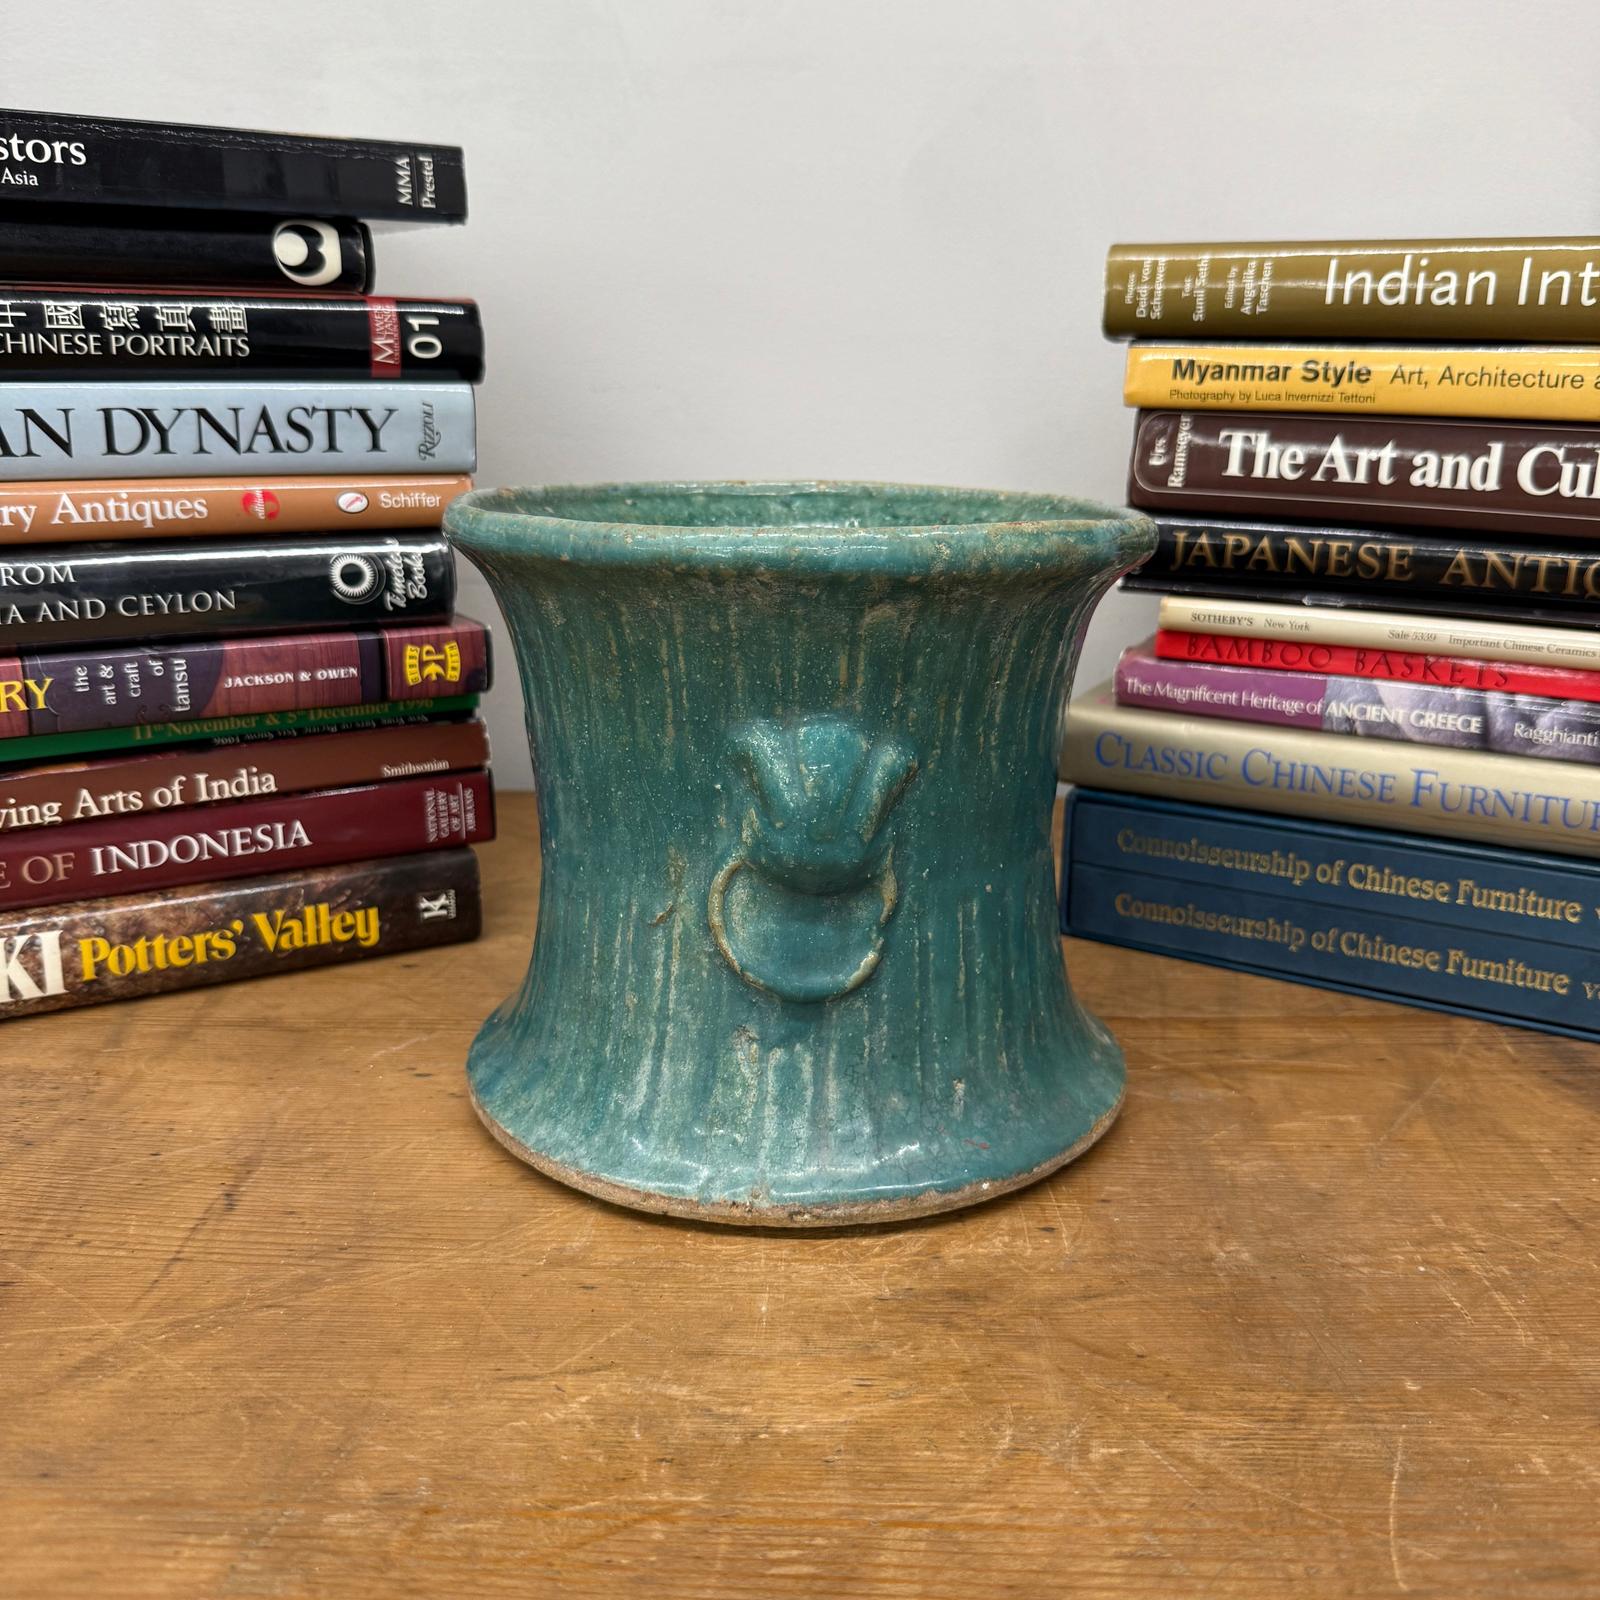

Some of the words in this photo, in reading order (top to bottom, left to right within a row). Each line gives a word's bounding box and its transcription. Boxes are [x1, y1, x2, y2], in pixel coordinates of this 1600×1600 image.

[1, 166, 39, 185] Asia
[396, 157, 413, 205] MMA
[418, 154, 436, 208] Prestel
[1241, 259, 1257, 315] Angelika
[1256, 260, 1273, 315] Taschen
[1324, 255, 1497, 306] Indian
[0, 332, 102, 355] HINESE
[112, 333, 250, 357] PORTRAITS
[405, 315, 442, 359] 01
[1169, 389, 1235, 402] Photography
[1238, 390, 1251, 403] by
[1255, 390, 1281, 402] Luca
[1285, 391, 1334, 403] Invernizzi
[1338, 391, 1376, 404] Tettoni
[1171, 358, 1292, 386] Myanmar
[1301, 359, 1372, 388] Style
[1389, 365, 1428, 388] Art,
[1437, 366, 1585, 390] Architecture
[98, 405, 399, 456] DYNASTY
[1218, 430, 1306, 481] The
[1311, 433, 1398, 485] Art
[1409, 441, 1503, 492] and
[51, 492, 208, 529] Antiques
[380, 491, 441, 508] Schiffer
[403, 550, 428, 599] Book
[1170, 530, 1415, 582] JAPANESE
[36, 598, 106, 622] AND
[118, 589, 237, 617] CEYLON
[1190, 612, 1254, 626] SOTHEBY'S
[1264, 618, 1285, 629] New
[1288, 620, 1310, 632] York
[1387, 629, 1409, 640] Sale
[1411, 630, 1437, 642] 5339
[1448, 634, 1500, 649] Important
[1503, 639, 1544, 653] Chinese
[1546, 643, 1597, 658] Ceramics
[74, 665, 89, 692] the
[99, 663, 114, 679] &
[124, 661, 141, 697] craft
[149, 659, 164, 676] of
[170, 658, 190, 712] tansu
[224, 672, 294, 689] JACKSON
[298, 671, 312, 683] &
[316, 666, 358, 681] OWEN
[1187, 634, 1332, 669] BAMBOO
[1354, 650, 1509, 688] BASKETS
[102, 682, 117, 705] art
[1124, 677, 1151, 695] The
[1153, 681, 1238, 703] Magnificent
[1241, 691, 1305, 715] Heritage
[1306, 699, 1323, 714] of
[1324, 702, 1409, 725] ANCIENT
[1409, 709, 1484, 735] GREECE
[168, 715, 258, 736] November
[265, 713, 280, 725] &
[306, 702, 390, 721] December
[383, 758, 450, 777] Smithsonian
[1094, 731, 1229, 781] CLASSIC
[1240, 748, 1396, 803] CHINESE
[72, 784, 143, 819] Arts
[152, 774, 186, 808] of
[199, 766, 278, 800] India
[22, 852, 75, 885] OF
[90, 819, 313, 877] INDONESIA
[1116, 828, 1311, 887] Connoisseurship
[1316, 859, 1346, 885] of
[1348, 862, 1451, 904] Chinese
[1456, 878, 1583, 925] Furniture
[78, 918, 243, 982] Potters'
[251, 901, 381, 954] Valley
[1114, 892, 1306, 951] Connoisseurship
[1311, 927, 1339, 953] of
[1340, 931, 1440, 974] Chinese
[1445, 950, 1571, 996] Furniture
